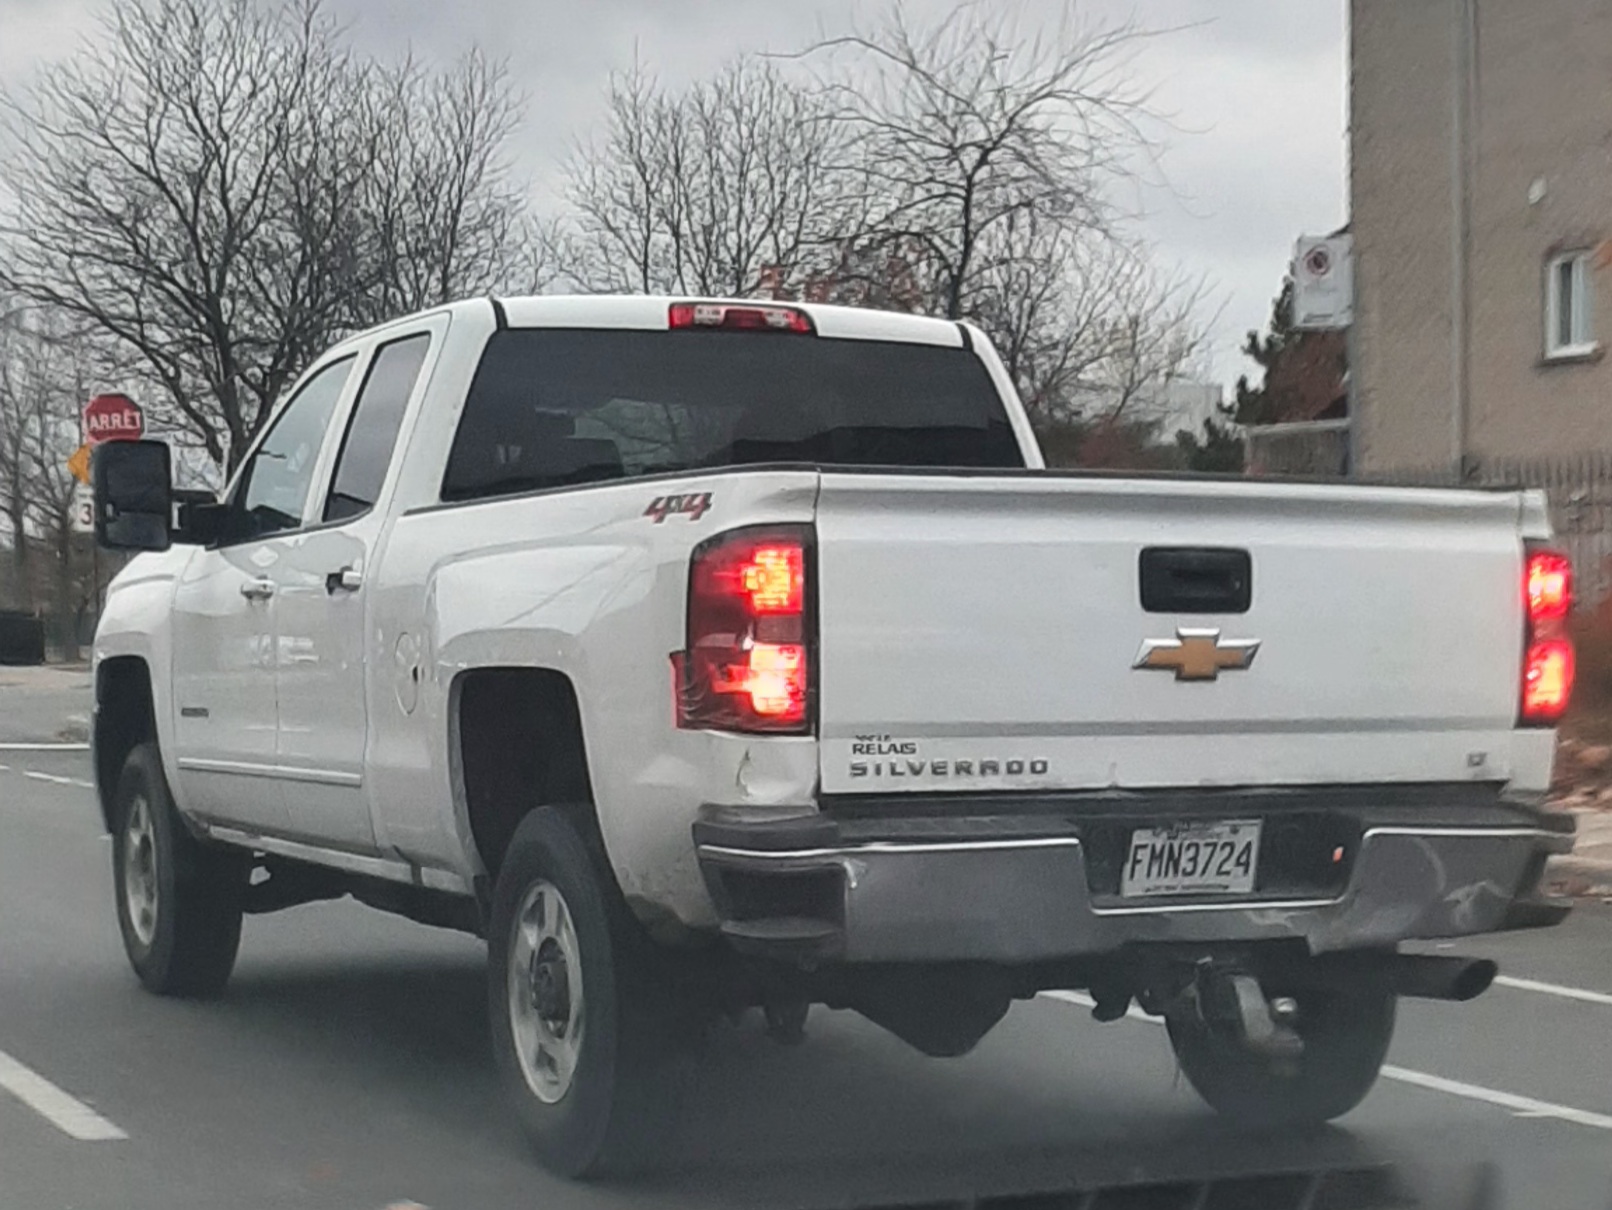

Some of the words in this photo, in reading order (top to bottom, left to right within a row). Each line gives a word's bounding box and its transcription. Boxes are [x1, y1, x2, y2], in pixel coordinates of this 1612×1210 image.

[89, 408, 141, 430] ARRÊT
[852, 742, 917, 755] RELAIS
[850, 759, 1048, 777] SILVERADO
[1129, 840, 1253, 881] FMN3724
